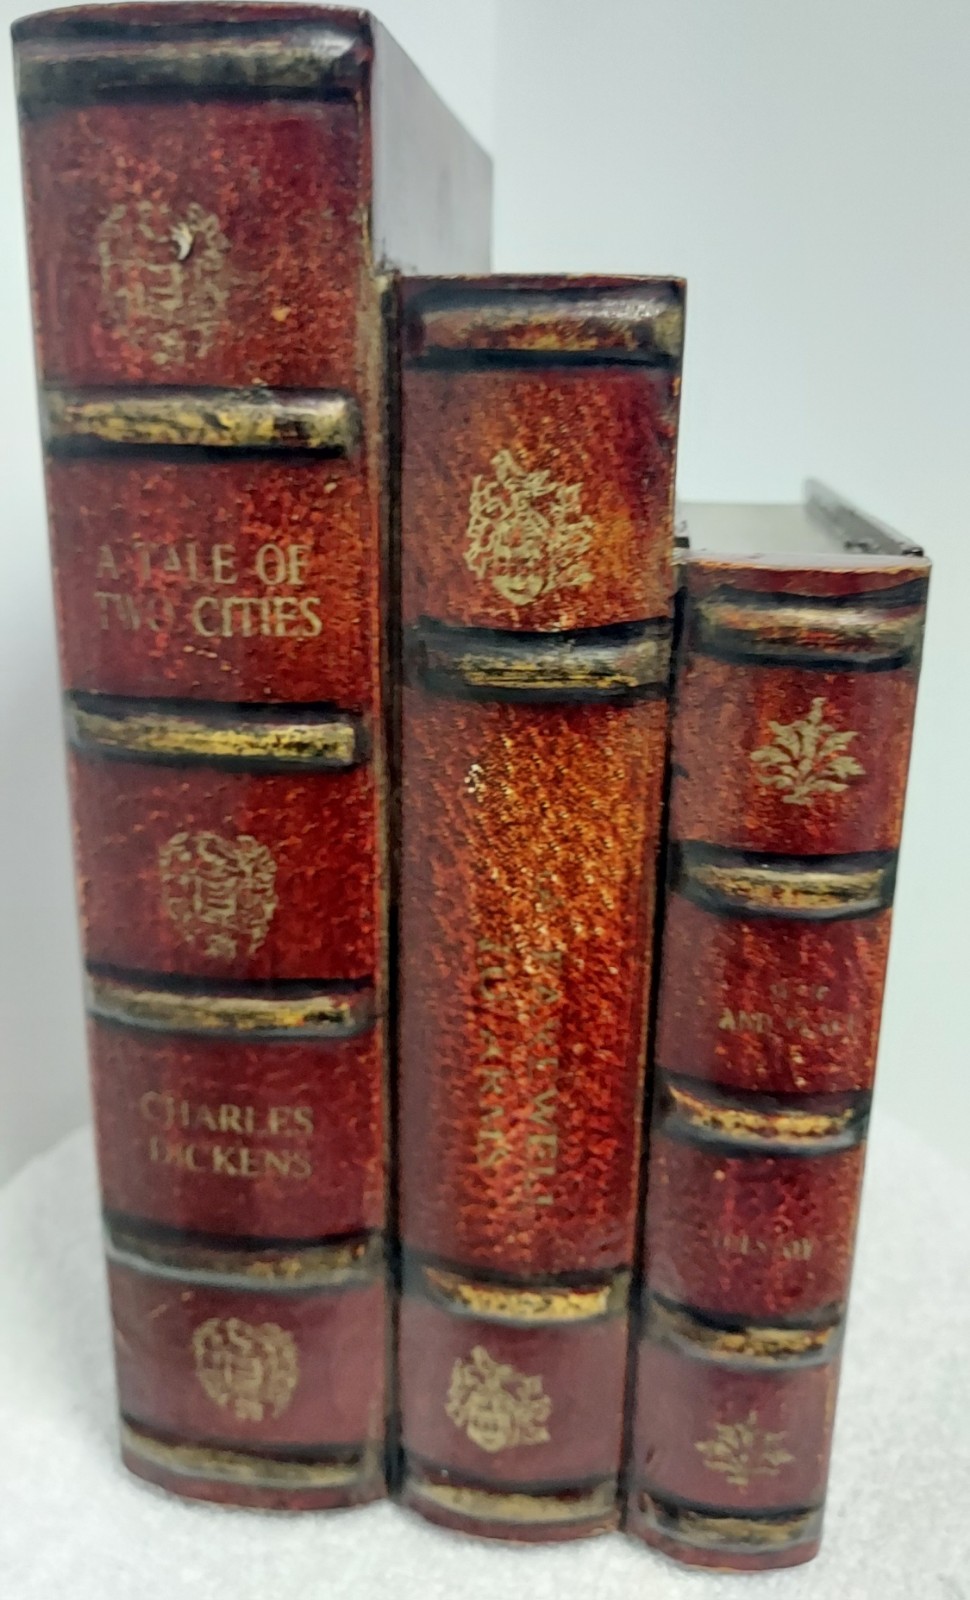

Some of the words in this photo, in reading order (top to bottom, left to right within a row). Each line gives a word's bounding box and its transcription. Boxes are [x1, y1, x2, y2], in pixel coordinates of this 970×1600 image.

[95, 545, 119, 580] A
[256, 543, 313, 586] OF
[94, 591, 176, 632] TWO
[192, 596, 323, 638] CITIES
[139, 1090, 314, 1137] CHARLES
